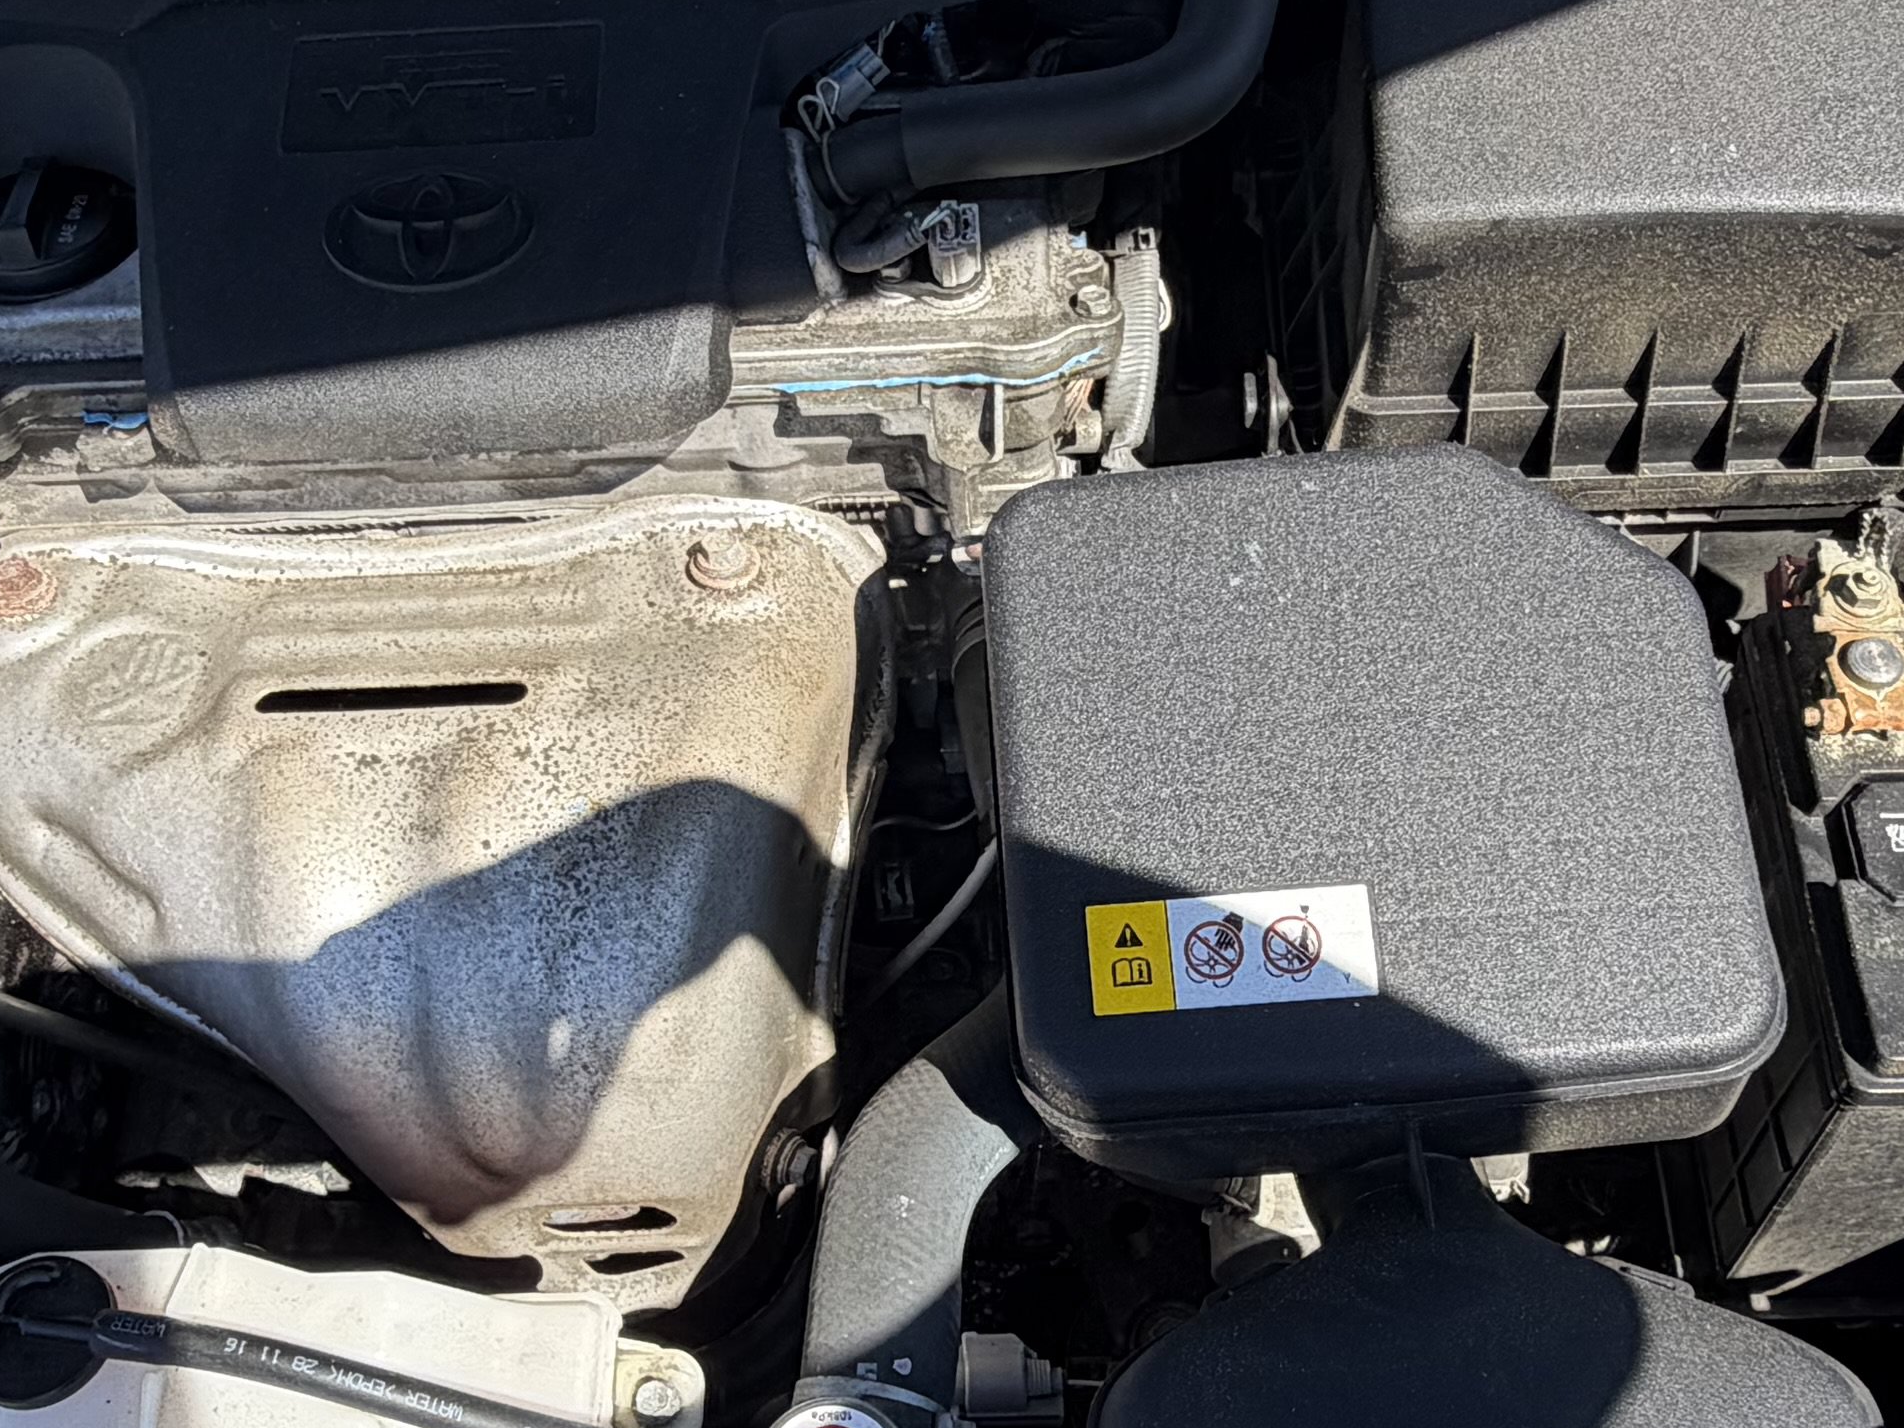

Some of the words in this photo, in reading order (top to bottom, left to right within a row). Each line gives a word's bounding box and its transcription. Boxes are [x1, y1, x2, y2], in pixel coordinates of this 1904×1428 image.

[110, 1317, 166, 1338] WATER
[223, 1336, 247, 1356] 16
[260, 1345, 279, 1365] 11
[292, 1355, 319, 1375] 28
[404, 1388, 464, 1423] WATER
